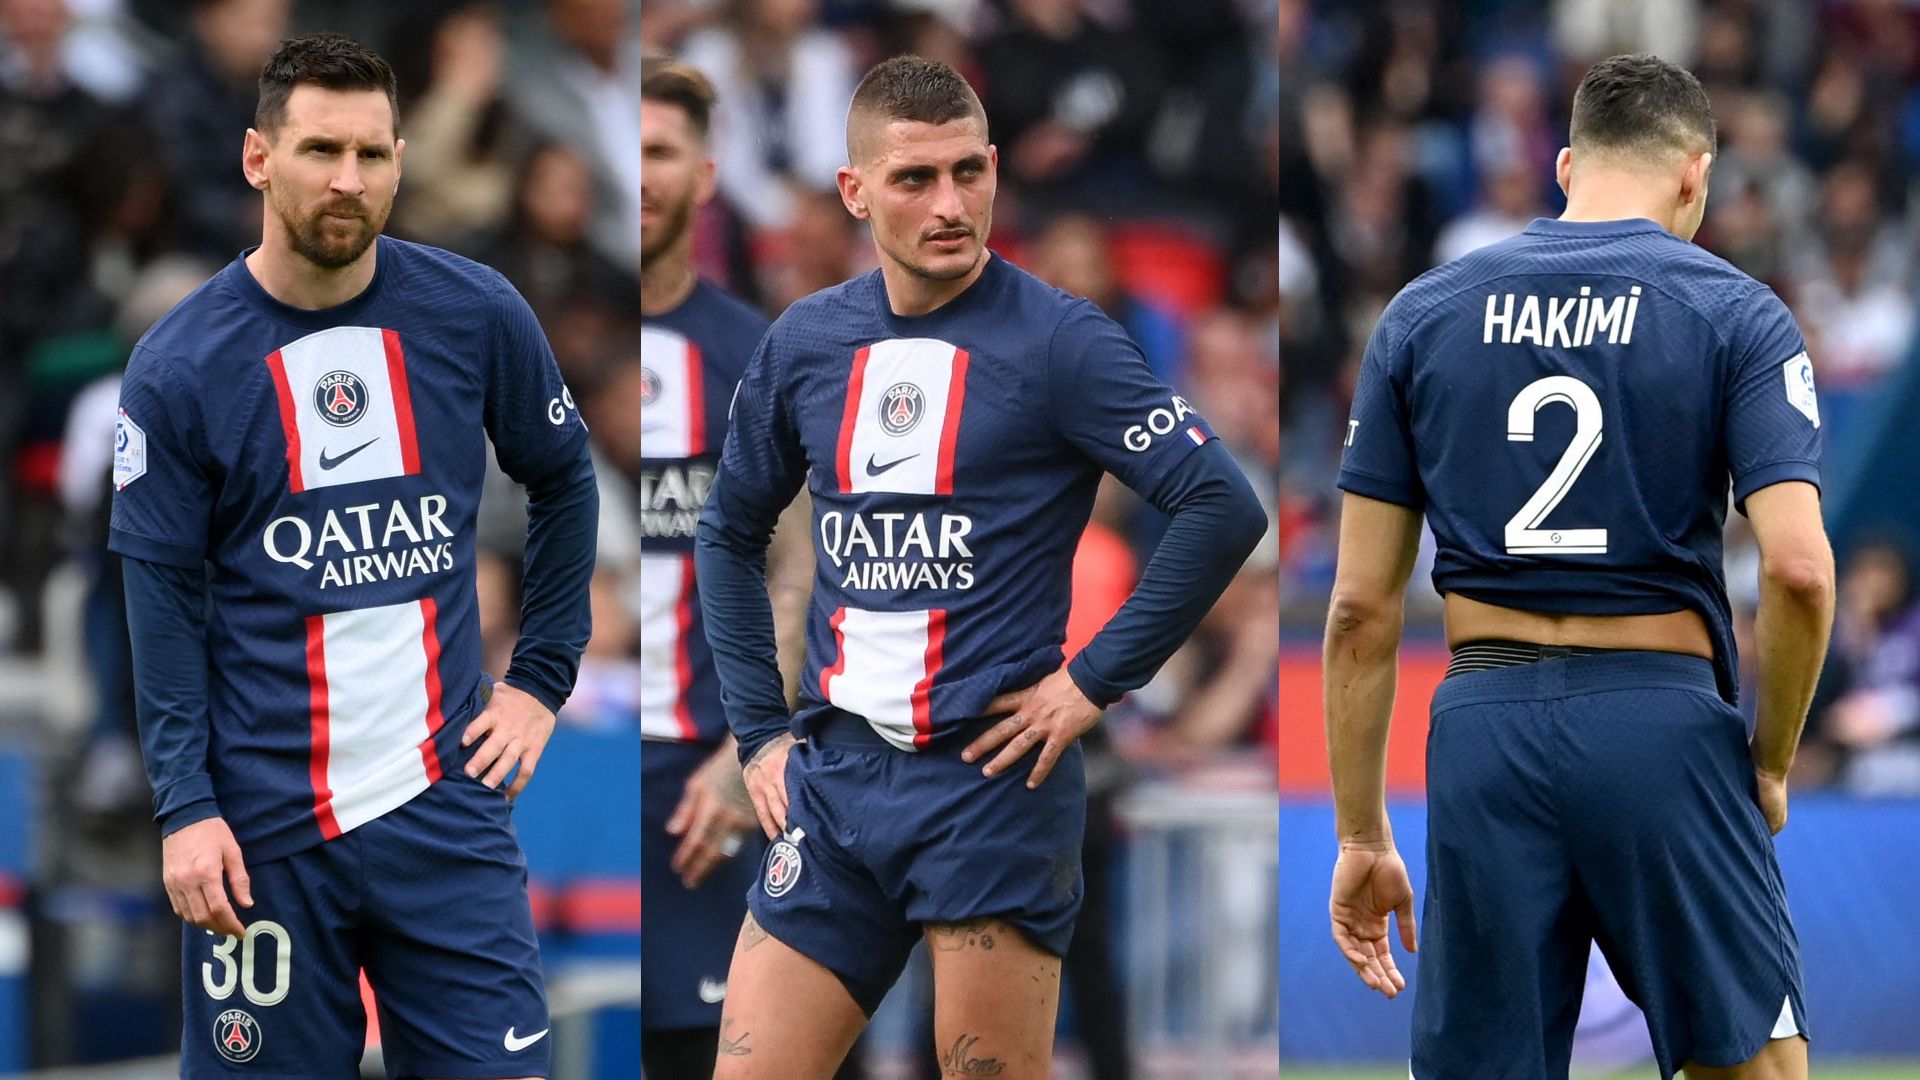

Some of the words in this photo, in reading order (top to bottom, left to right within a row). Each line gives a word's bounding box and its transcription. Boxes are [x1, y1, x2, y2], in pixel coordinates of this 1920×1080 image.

[320, 374, 355, 390] PARIS
[888, 386, 919, 400] PARIS
[1123, 395, 1197, 452] GOA
[1504, 375, 1608, 555] 2
[263, 494, 454, 571] QATAR
[820, 511, 974, 568] QATAR
[319, 542, 454, 590] AIRWAYS
[841, 561, 975, 590] AIRWAYS
[202, 920, 291, 1007] 30
[220, 1012, 253, 1027] PARIS
